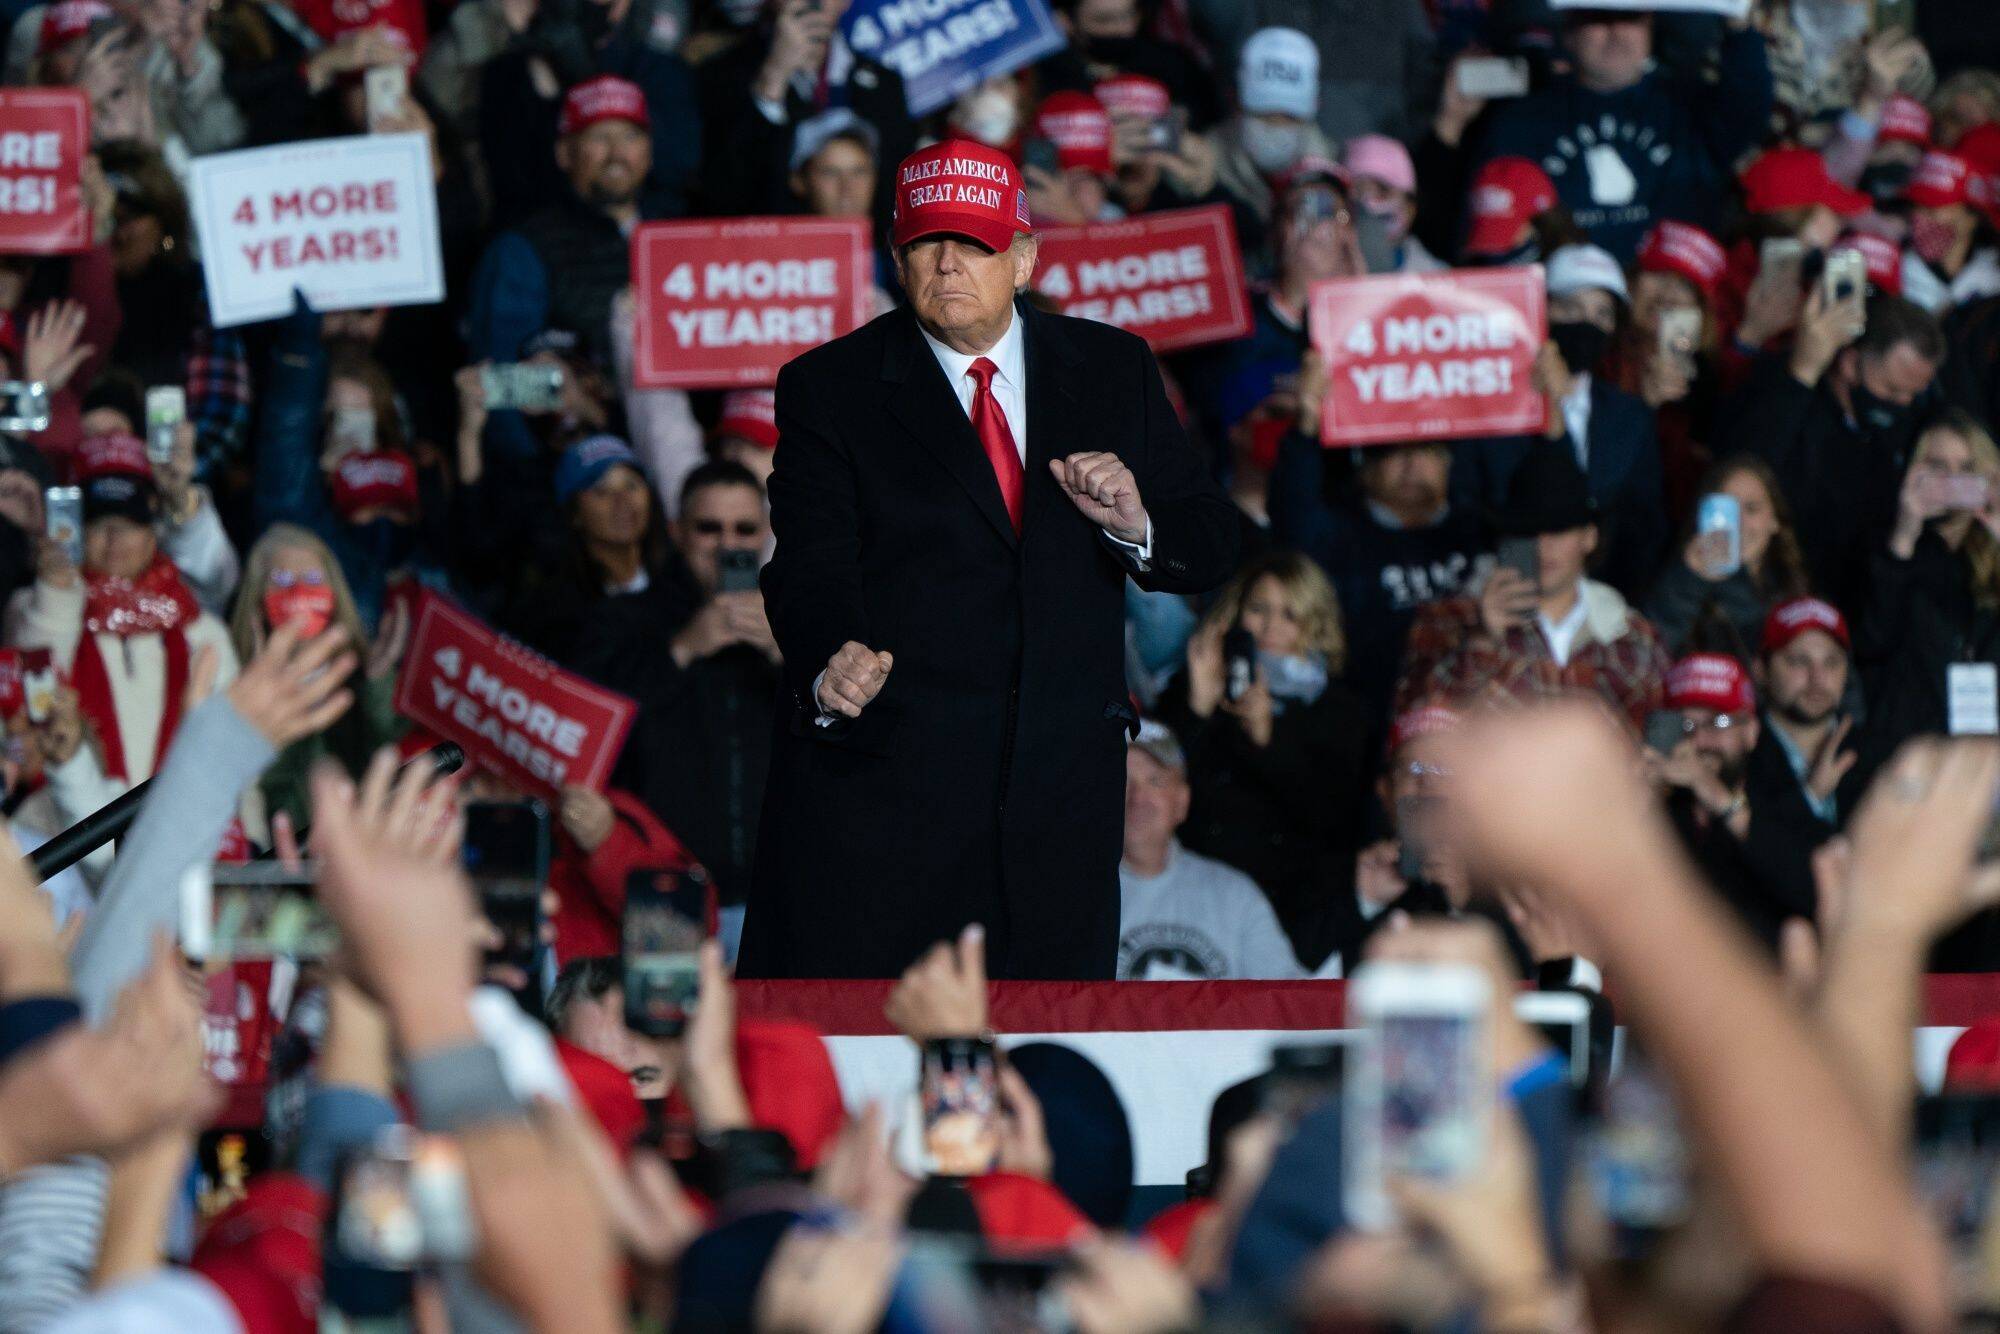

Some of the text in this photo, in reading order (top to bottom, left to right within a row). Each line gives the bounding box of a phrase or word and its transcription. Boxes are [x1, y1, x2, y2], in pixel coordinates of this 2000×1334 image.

[881, 0, 1019, 75] EARS!
[1, 131, 61, 169] RE
[902, 158, 1009, 186] MAKE AMERICA
[232, 179, 398, 226] 4 MORE
[910, 184, 1001, 209] GREAT AGAIN
[240, 226, 399, 274] YEARS!
[1039, 246, 1208, 299] 4 MORE
[662, 257, 838, 300] 4 MORE
[667, 305, 834, 348] YEARS!
[1345, 311, 1514, 356] 4 MORE
[1350, 358, 1512, 402] YEARS!
[433, 647, 462, 679] 4
[465, 663, 588, 758] MORE
[431, 675, 566, 785] YEARS!
